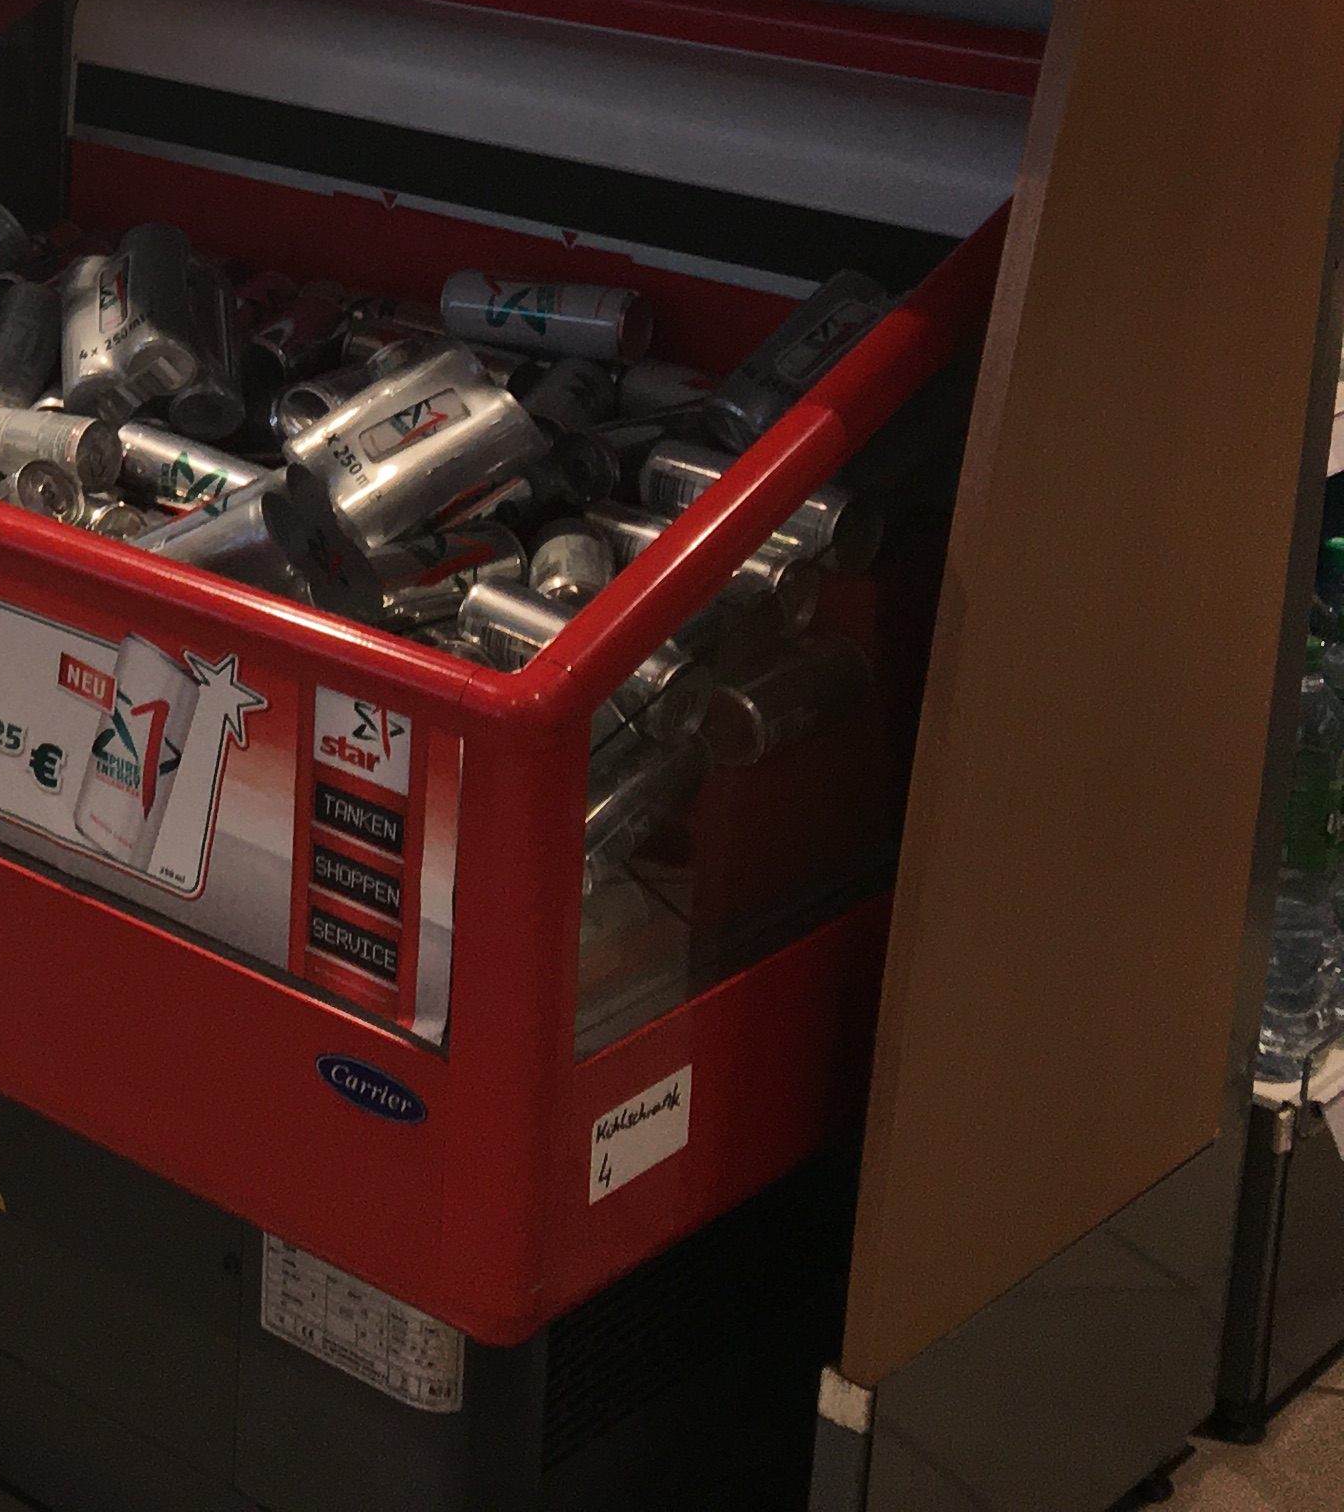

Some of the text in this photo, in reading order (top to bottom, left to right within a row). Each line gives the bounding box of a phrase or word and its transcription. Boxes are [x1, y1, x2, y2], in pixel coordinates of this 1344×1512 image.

[67, 663, 106, 700] NEU
[30, 742, 64, 789] €
[320, 733, 381, 773] star
[323, 793, 398, 842] TANKEN
[314, 855, 400, 910] SHOPPEN
[312, 917, 397, 973] SERVICE
[330, 1064, 414, 1115] Carrier
[598, 1152, 613, 1189] 4
